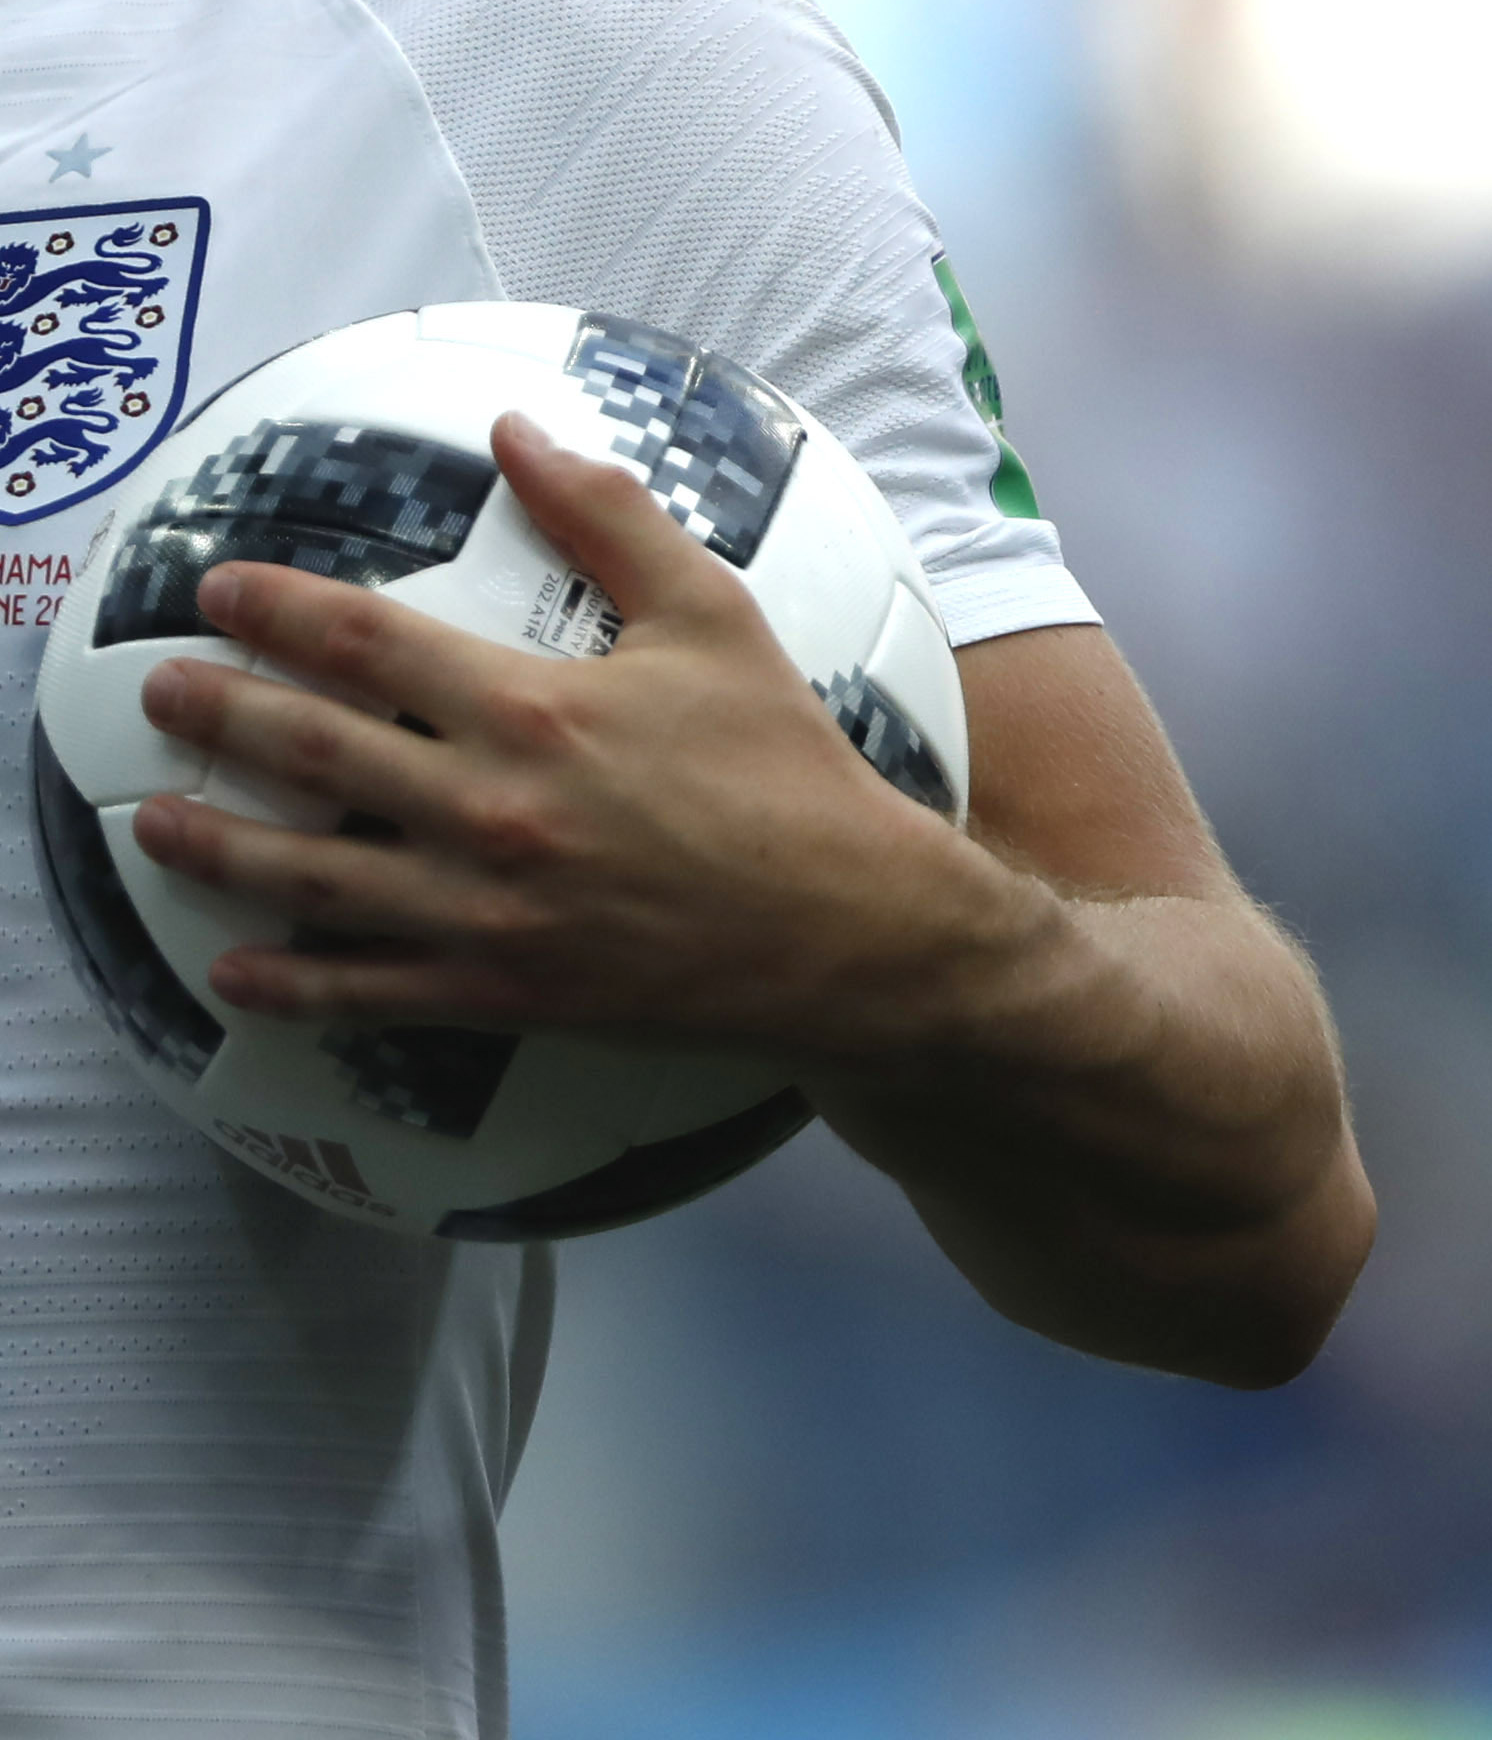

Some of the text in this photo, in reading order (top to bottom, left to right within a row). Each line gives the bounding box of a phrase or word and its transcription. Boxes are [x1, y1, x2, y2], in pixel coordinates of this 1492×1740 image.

[551, 618, 569, 642] PRO
[570, 586, 605, 651] QUALITY
[584, 596, 624, 656] IFA
[213, 1117, 398, 1217] adidas
